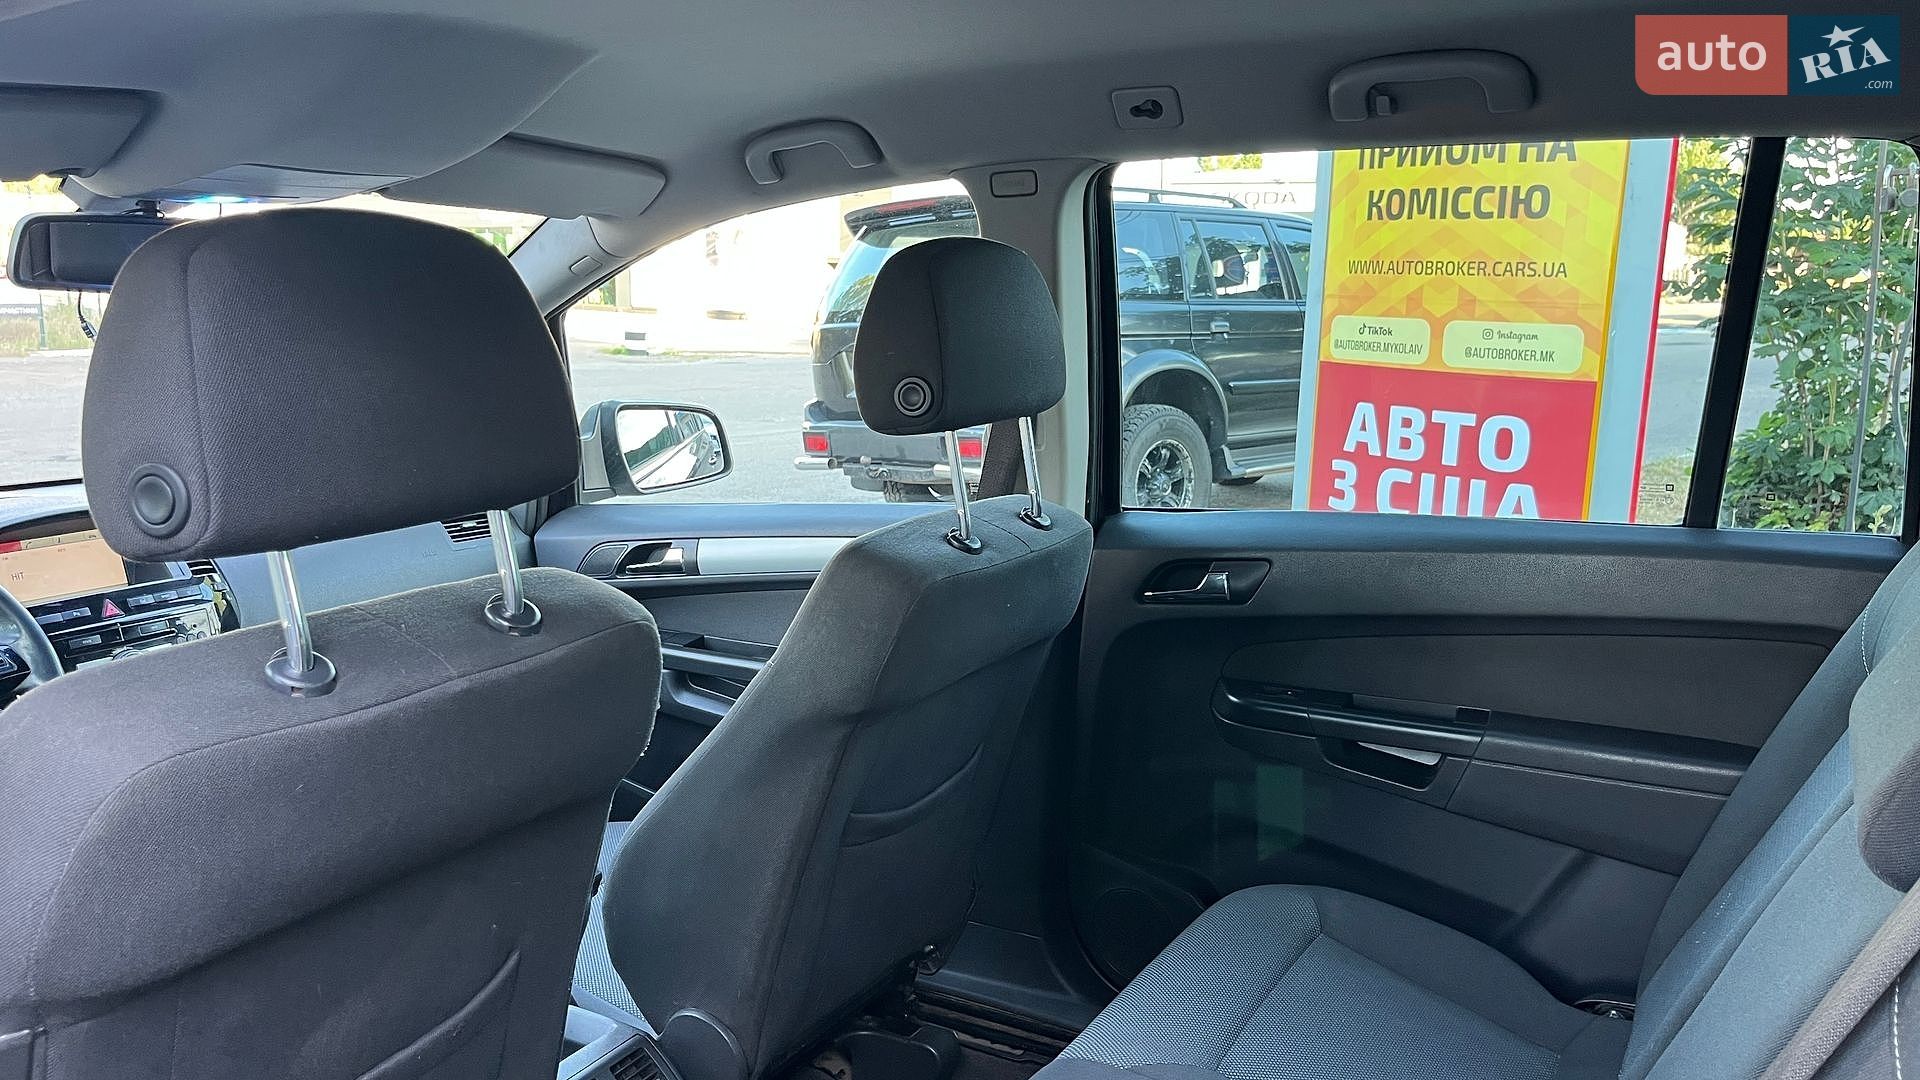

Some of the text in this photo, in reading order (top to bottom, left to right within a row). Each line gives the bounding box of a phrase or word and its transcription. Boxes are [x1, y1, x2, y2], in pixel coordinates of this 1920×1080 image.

[1518, 141, 1577, 162] НА
[1366, 184, 1551, 221] КОМІССІЮ
[1348, 259, 1568, 278] WWW.AUTOBROKER.CARS.UA
[1367, 326, 1393, 336] TikTok
[1497, 330, 1539, 343] Instagram
[1334, 338, 1423, 354] @AUTOBROKER.MYKOLAIV
[1464, 346, 1556, 362] @AUTOBROKER.MK
[1343, 401, 1531, 473] АВТО
[1376, 467, 1540, 518] США
